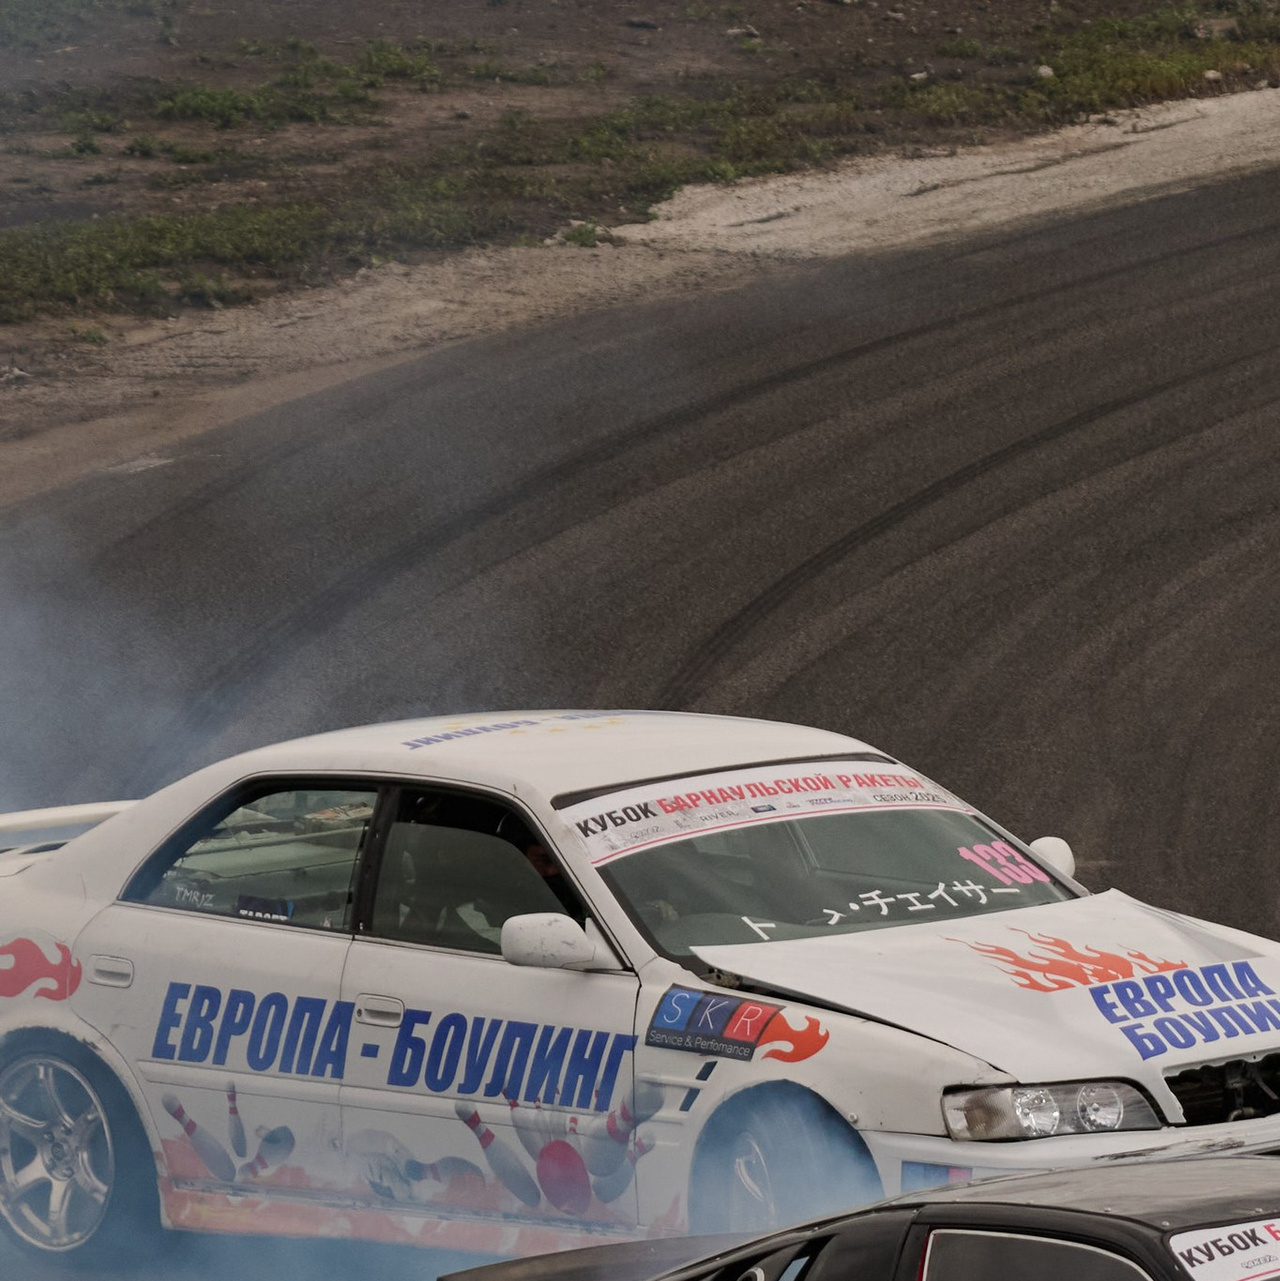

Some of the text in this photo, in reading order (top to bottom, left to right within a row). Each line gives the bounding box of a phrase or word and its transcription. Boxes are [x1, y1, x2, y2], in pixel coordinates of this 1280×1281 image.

[576, 802, 659, 838] КУБОК
[657, 773, 836, 815] БАРНАУЛЬСКОЙ
[835, 773, 926, 790] РАКЕТЫ
[957, 841, 1050, 885] 133
[663, 992, 763, 1036] SKR
[1089, 961, 1277, 1024] ЕВРОПА
[152, 981, 356, 1080] ЕВРОПА
[387, 1009, 639, 1112] БОУЛИНГ
[650, 1030, 684, 1046] Service
[684, 1036, 693, 1047] &
[1178, 1228, 1268, 1268] КУБОК
